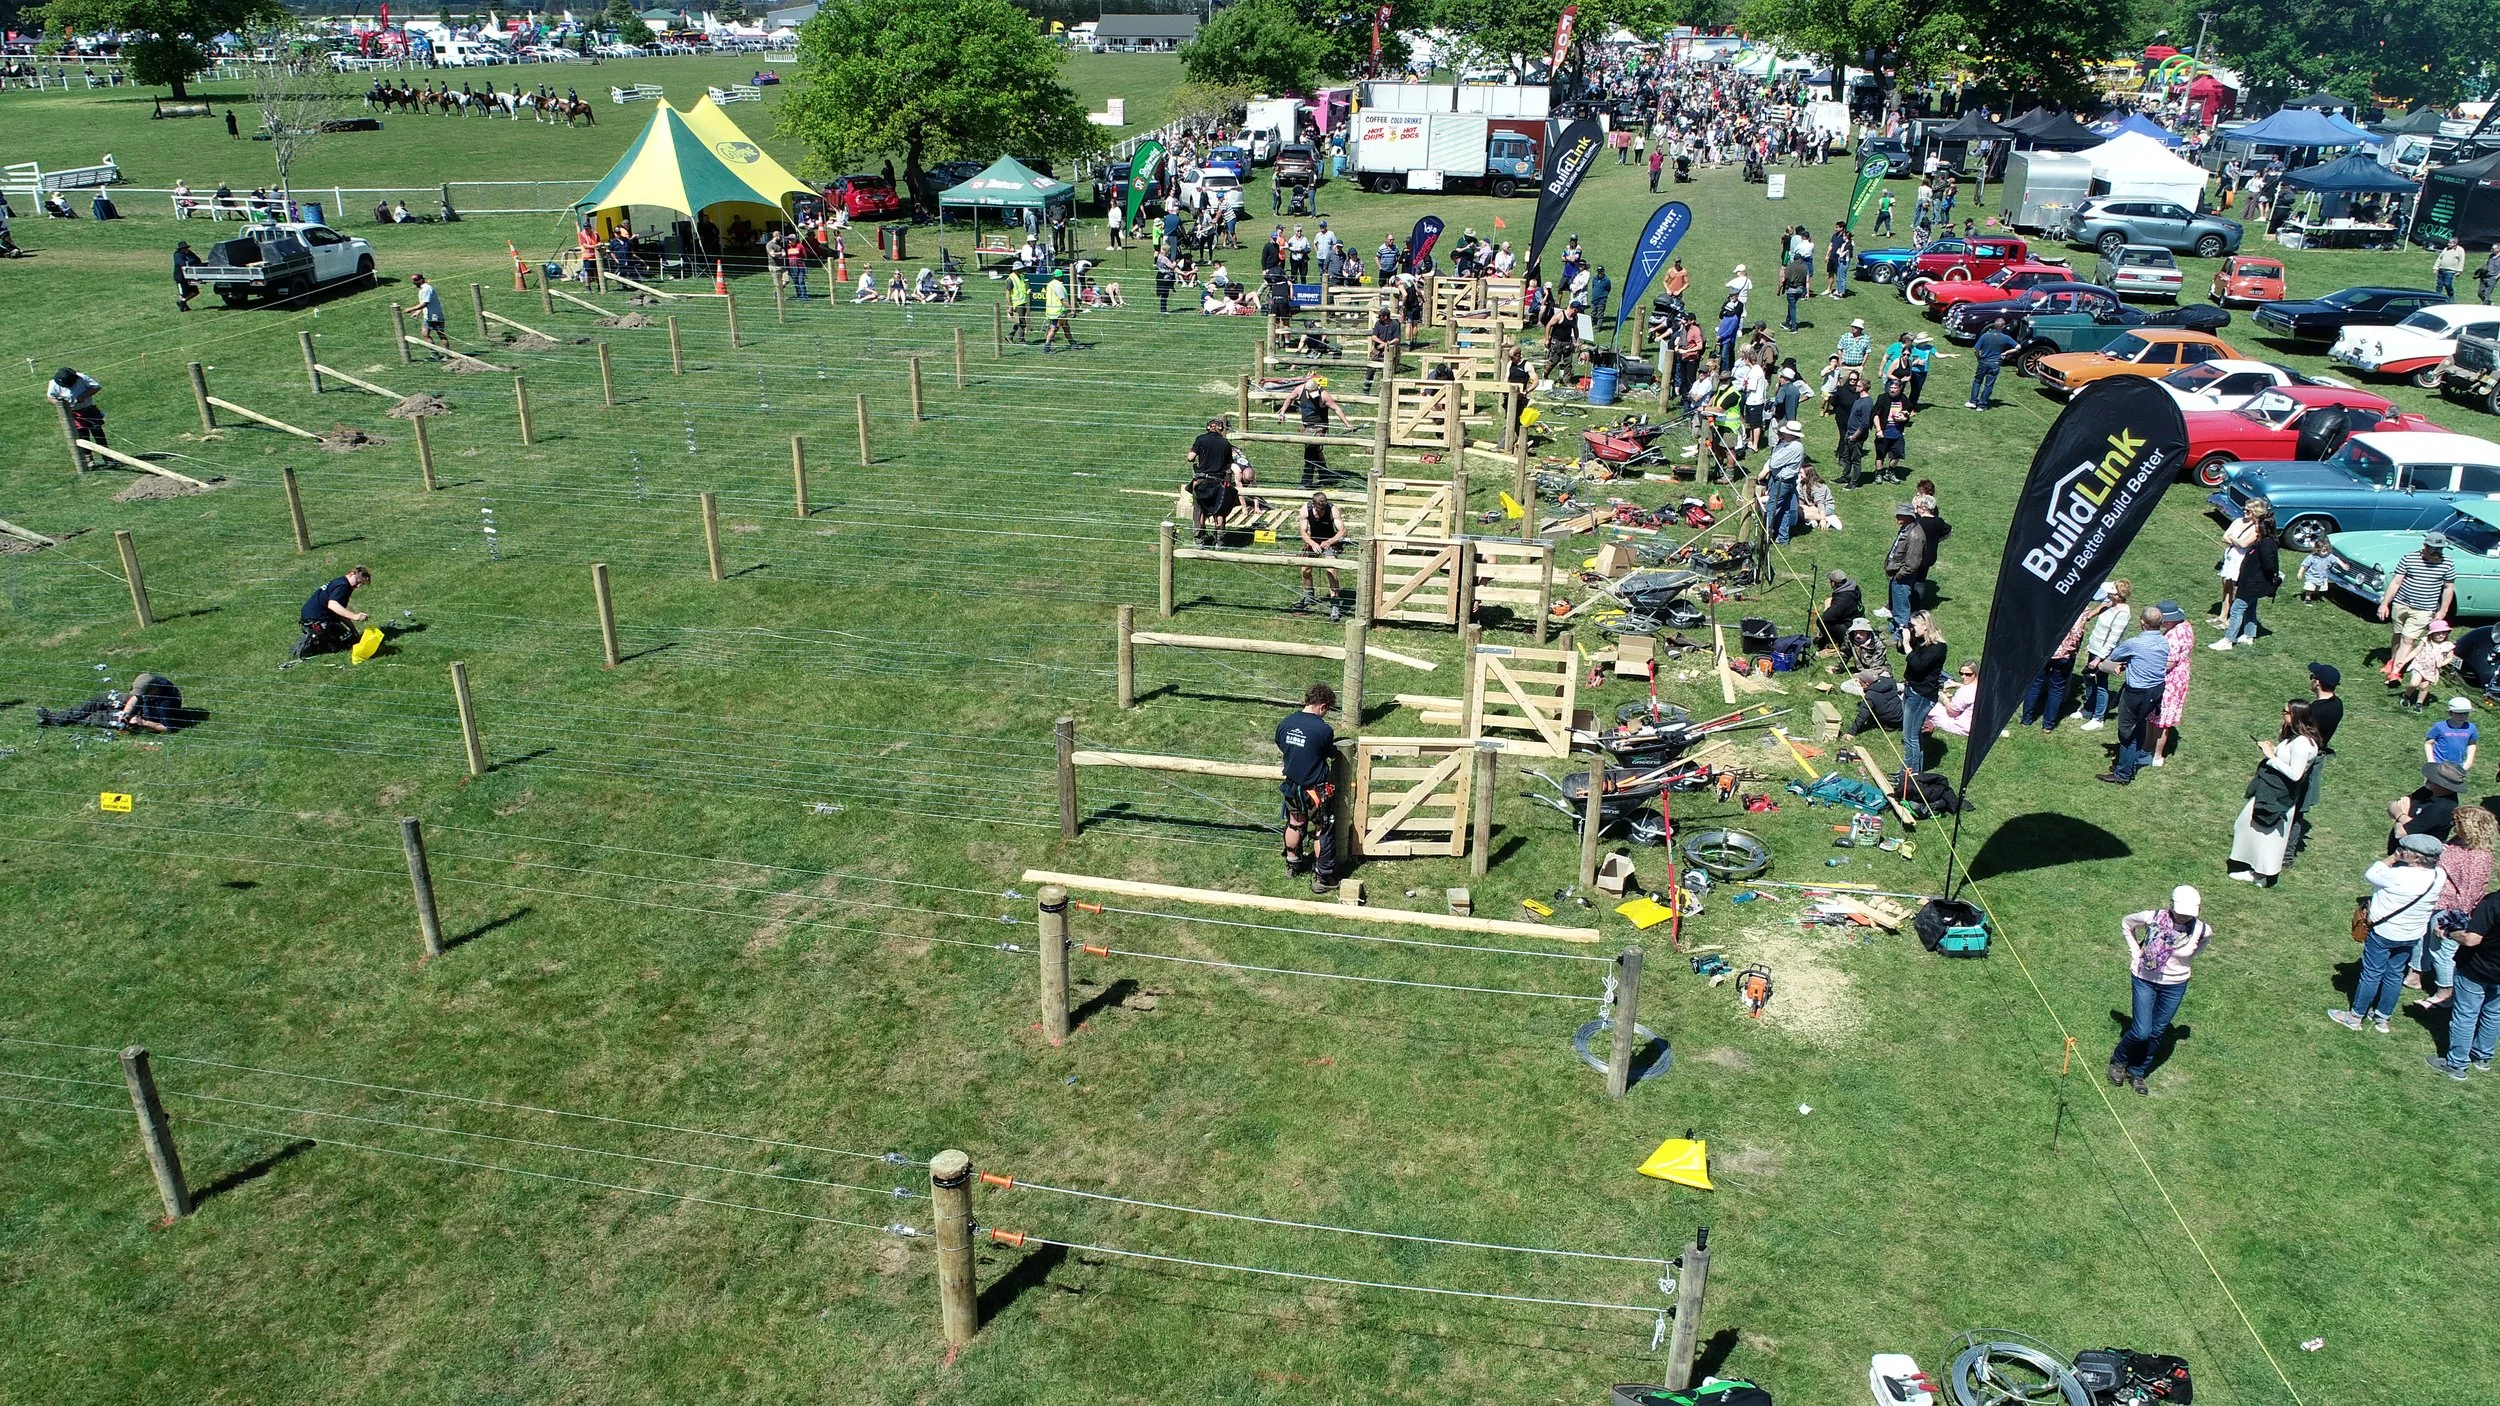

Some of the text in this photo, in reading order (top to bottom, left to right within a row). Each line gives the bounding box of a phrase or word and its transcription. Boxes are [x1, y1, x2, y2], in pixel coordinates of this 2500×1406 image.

[1554, 14, 1573, 63] FOO
[1400, 132, 1419, 140] DOGS
[1548, 136, 1592, 195] BuildLink
[1650, 209, 1677, 246] SUMMIT
[1656, 233, 1669, 249] STEEL
[1671, 214, 1682, 228] WIRE
[2021, 427, 2147, 582] BuildLink
[2054, 448, 2165, 595] Buy Better Build Better
